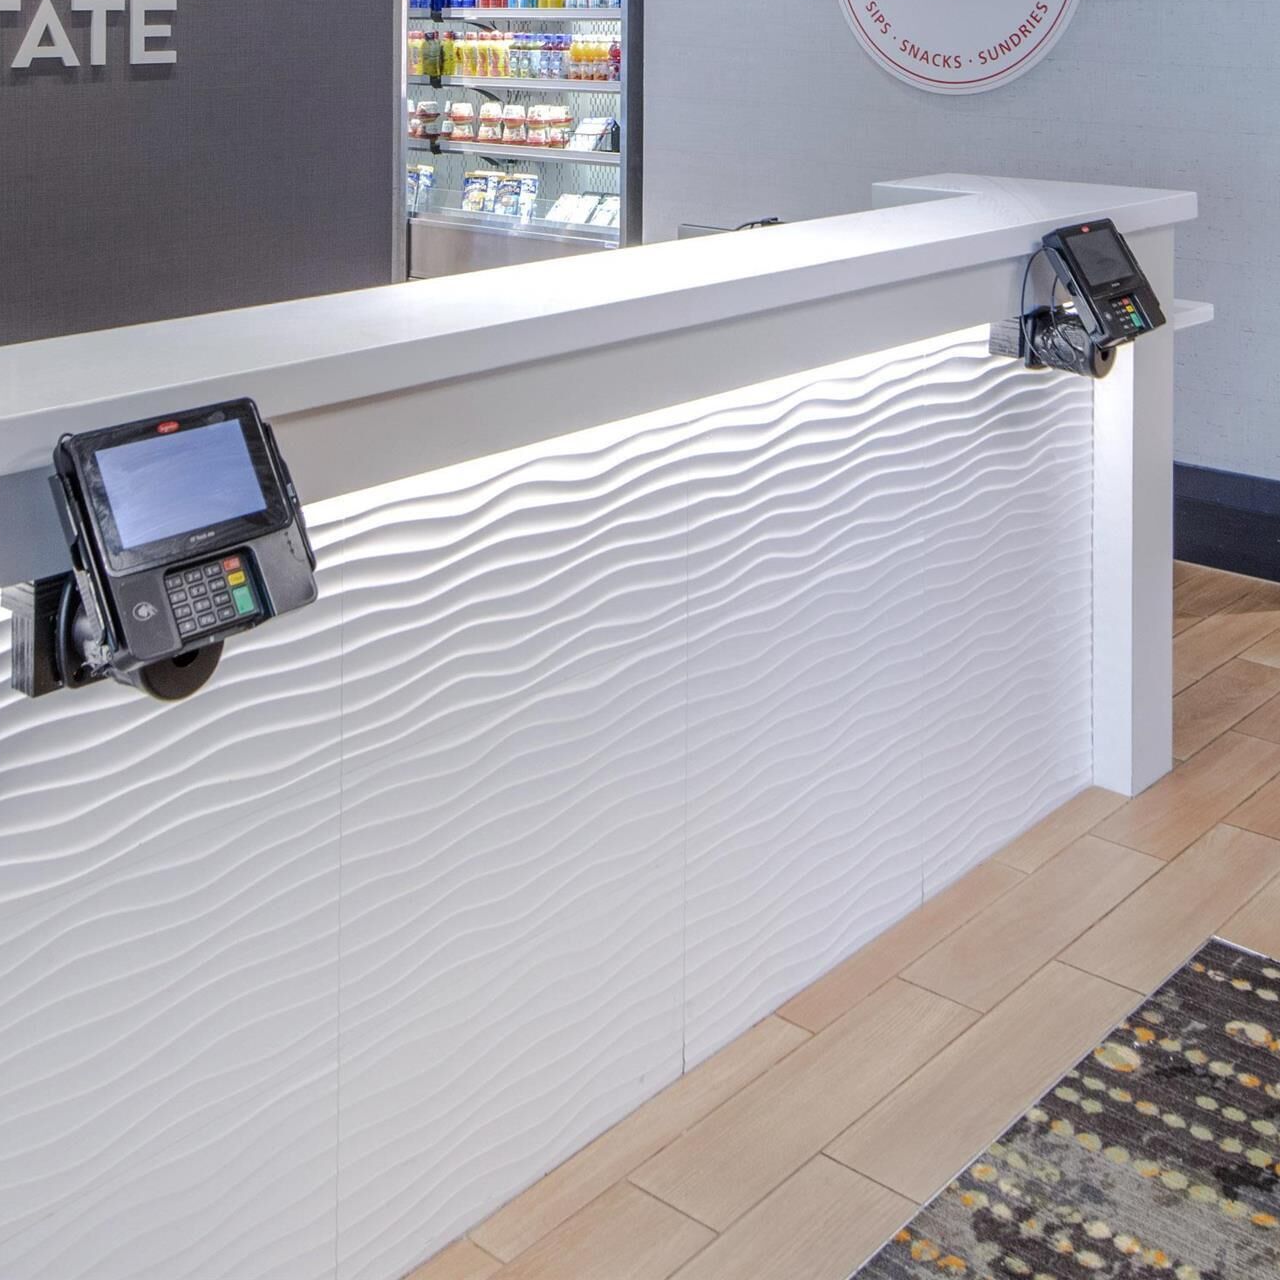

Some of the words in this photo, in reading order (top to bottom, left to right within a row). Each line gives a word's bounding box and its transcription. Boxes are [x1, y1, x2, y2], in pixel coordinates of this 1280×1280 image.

[865, 0, 892, 35] SIPS
[899, 39, 962, 69] SNACKS
[978, 1, 1049, 65] SUNDRIES
